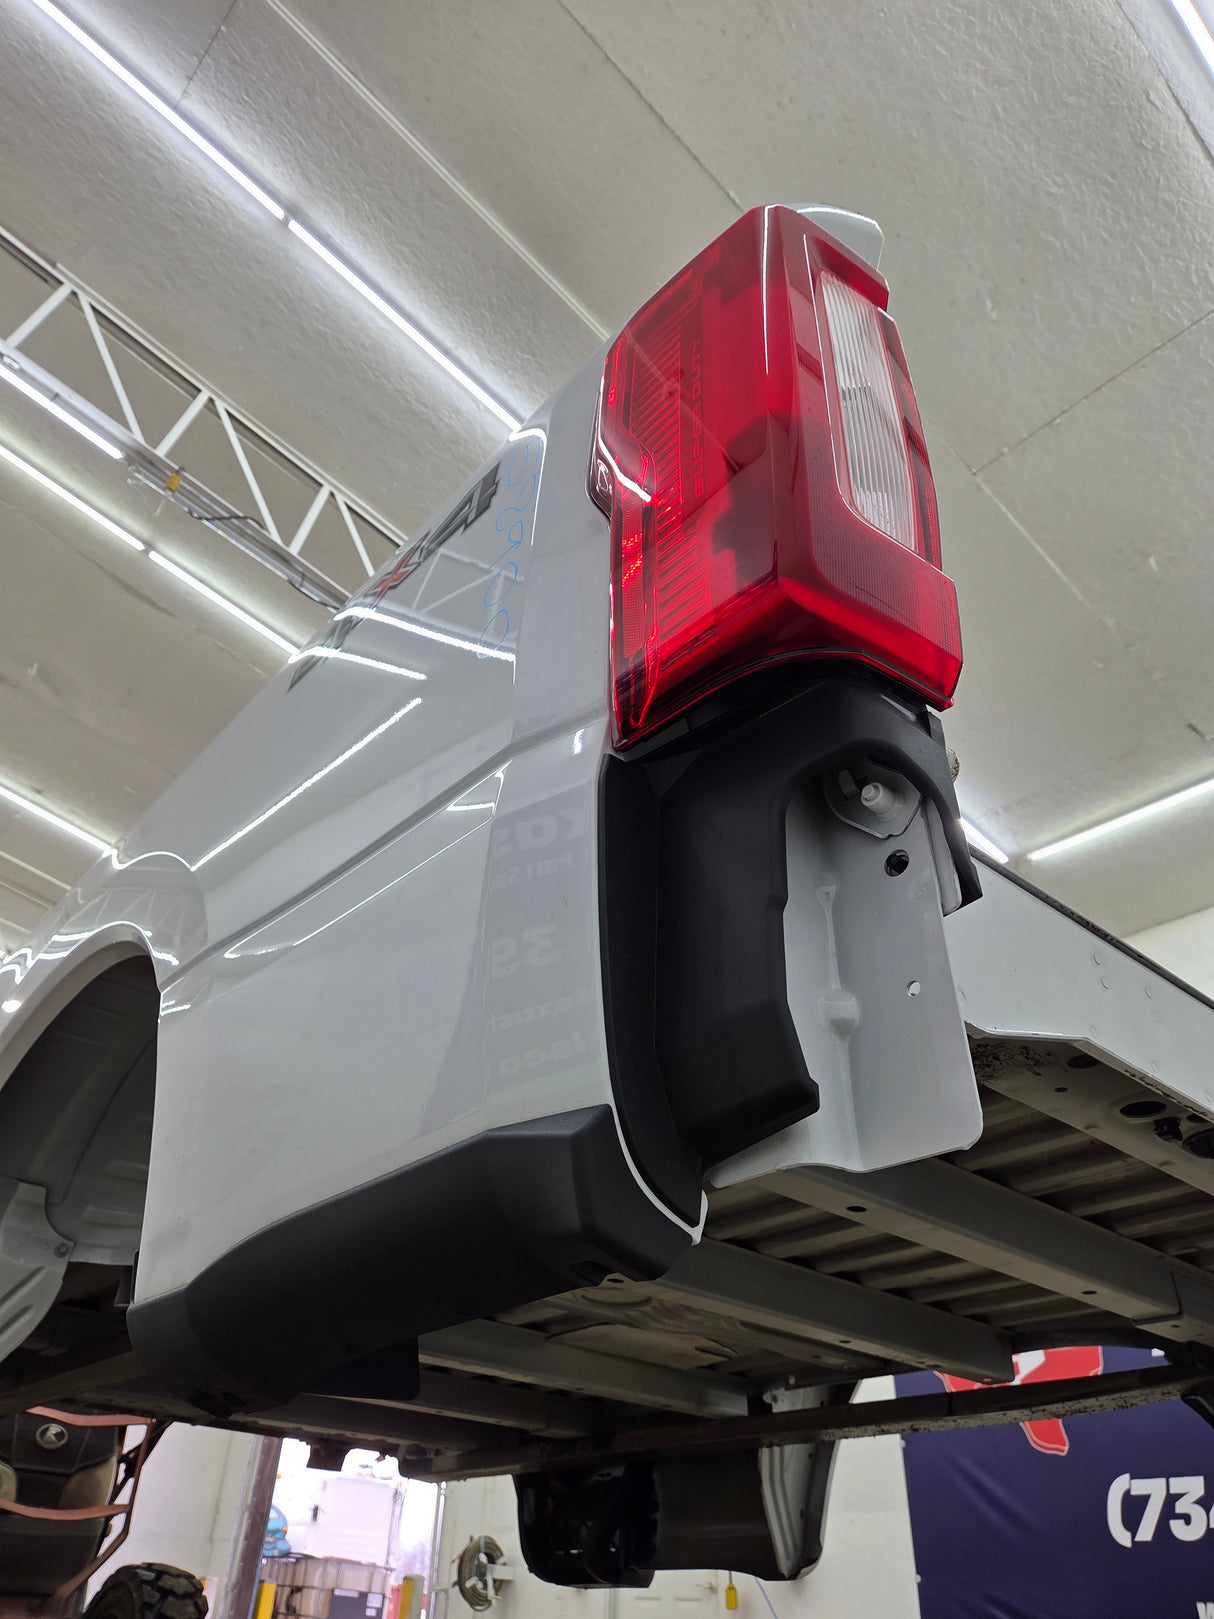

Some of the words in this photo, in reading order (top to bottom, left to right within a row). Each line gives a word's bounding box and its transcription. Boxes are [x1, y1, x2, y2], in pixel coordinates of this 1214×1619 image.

[691, 339, 702, 400] DUTY
[691, 400, 704, 498] SUPER
[1106, 1472, 1214, 1548] (73
